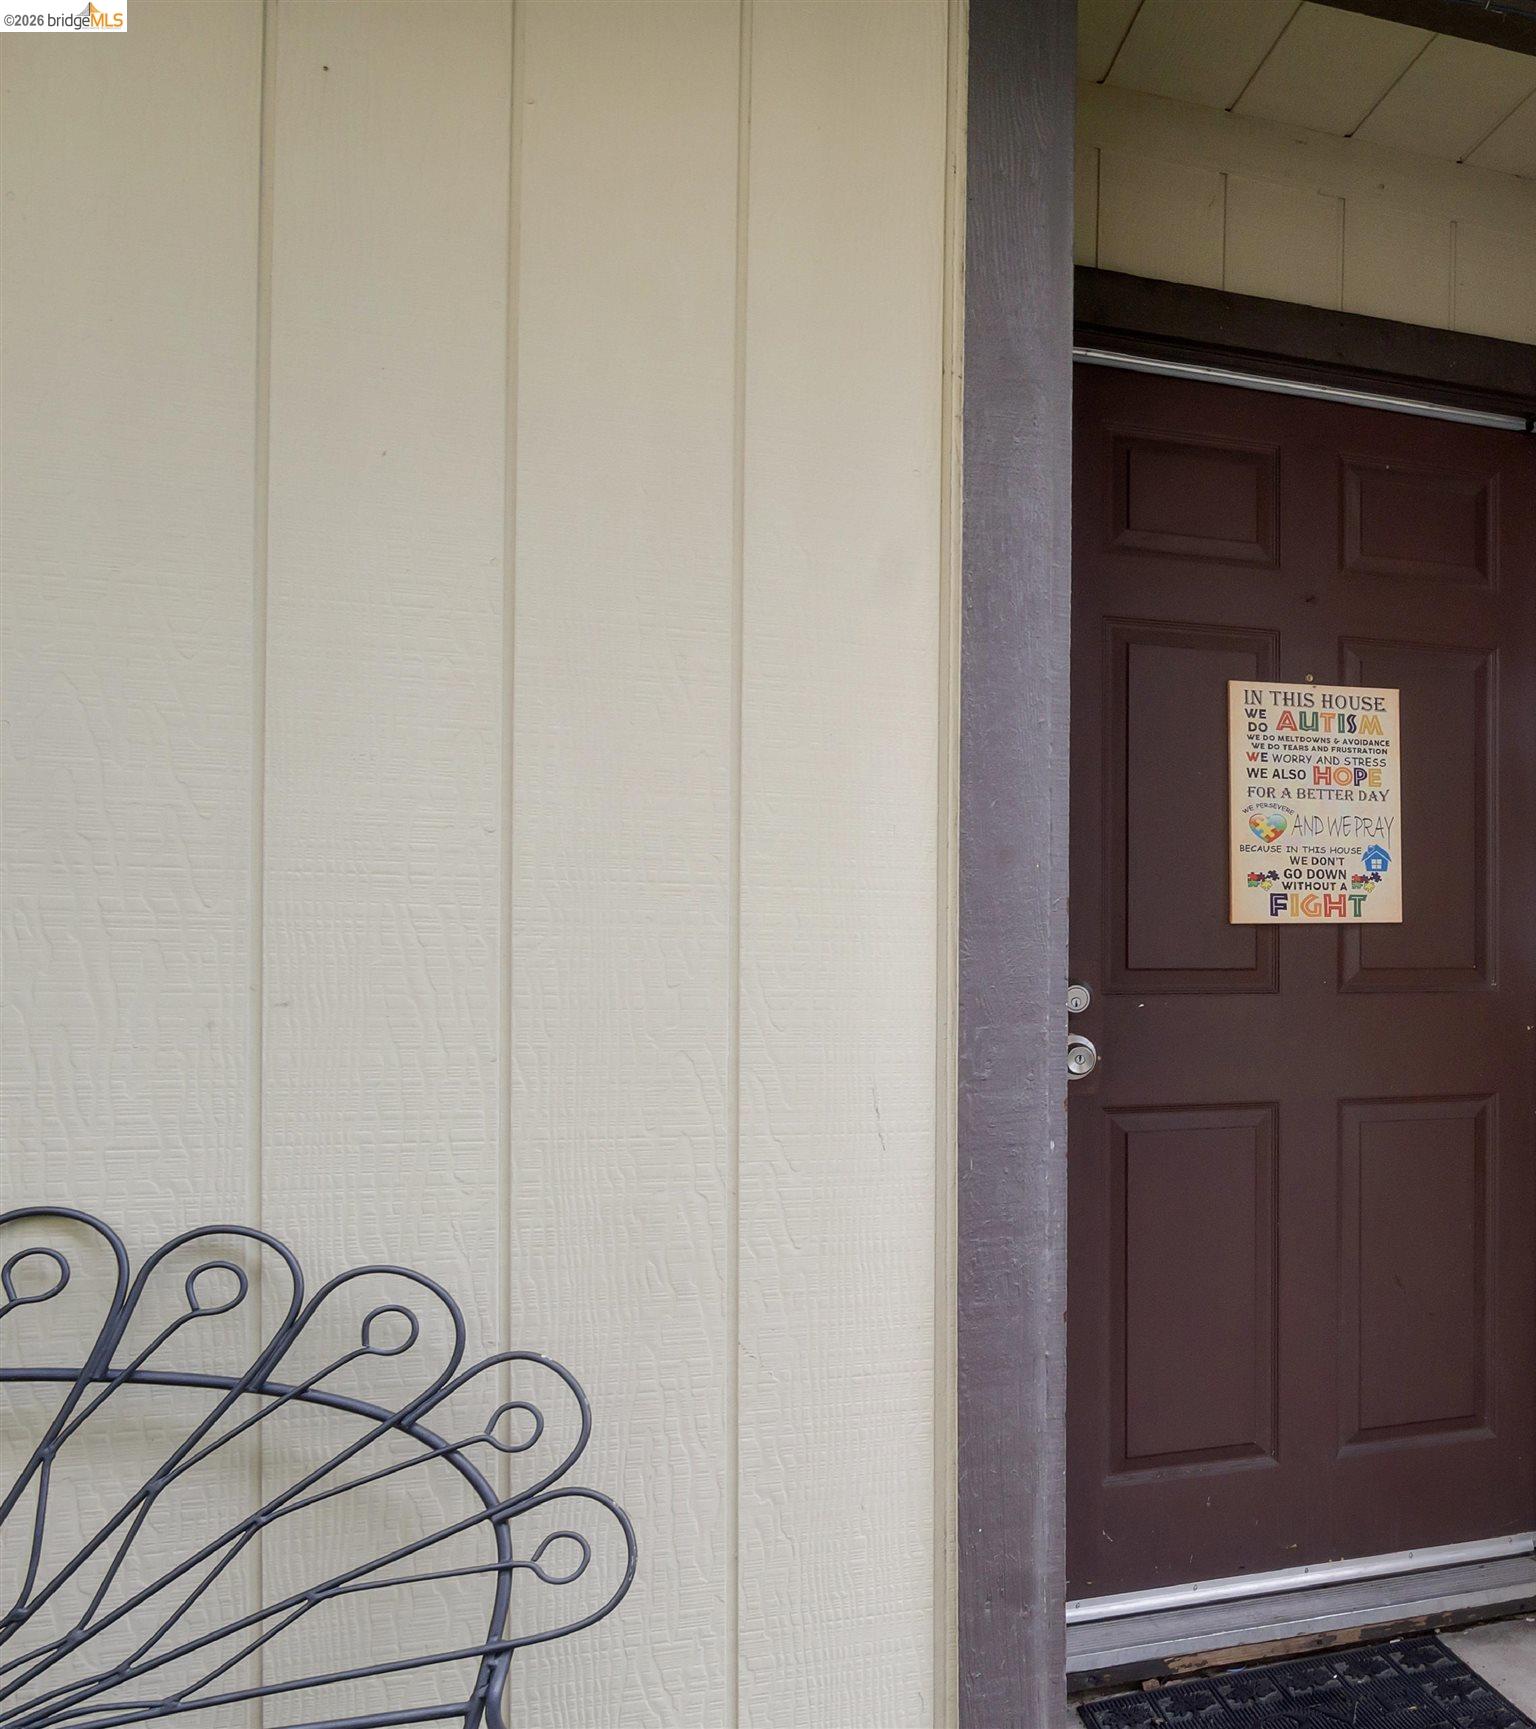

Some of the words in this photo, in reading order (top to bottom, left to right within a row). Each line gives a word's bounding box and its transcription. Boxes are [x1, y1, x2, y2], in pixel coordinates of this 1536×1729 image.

[1244, 689, 1262, 705] IN
[1269, 691, 1315, 708] THIS
[1322, 694, 1386, 712] HOUSE
[1244, 708, 1266, 718] WE
[1248, 722, 1268, 732] DO
[1275, 711, 1384, 736] AUTISM
[1278, 735, 1330, 743] MELTDOWNS
[1342, 738, 1390, 747] AVOIDANCE
[1331, 746, 1388, 754] FRUSTRATION
[1247, 752, 1268, 762] WE
[1272, 754, 1312, 764] WORRY
[1316, 756, 1340, 765] AND
[1344, 757, 1387, 767] STRESS
[1247, 768, 1268, 778] WE
[1272, 769, 1306, 780] ALSO
[1313, 766, 1382, 788] HOPE
[1248, 786, 1275, 798] FOR
[1282, 788, 1291, 799] A
[1296, 788, 1354, 800] BETTER
[1359, 790, 1390, 802] DAY
[1242, 805, 1254, 813] WE
[1256, 803, 1294, 815] PERSEVERE
[1291, 814, 1323, 838] AND
[1328, 816, 1351, 837] WE
[1355, 816, 1394, 848] PRAY
[1240, 845, 1282, 853] BECAUSE
[1330, 847, 1362, 855] HOUSE
[1290, 856, 1308, 865] WE
[1311, 857, 1345, 866] DON'T
[1283, 869, 1302, 879] GO
[1307, 870, 1347, 880] DOWN
[1282, 882, 1335, 891] WITHOUT
[1340, 883, 1347, 891] A
[1270, 893, 1367, 918] FIGHT
